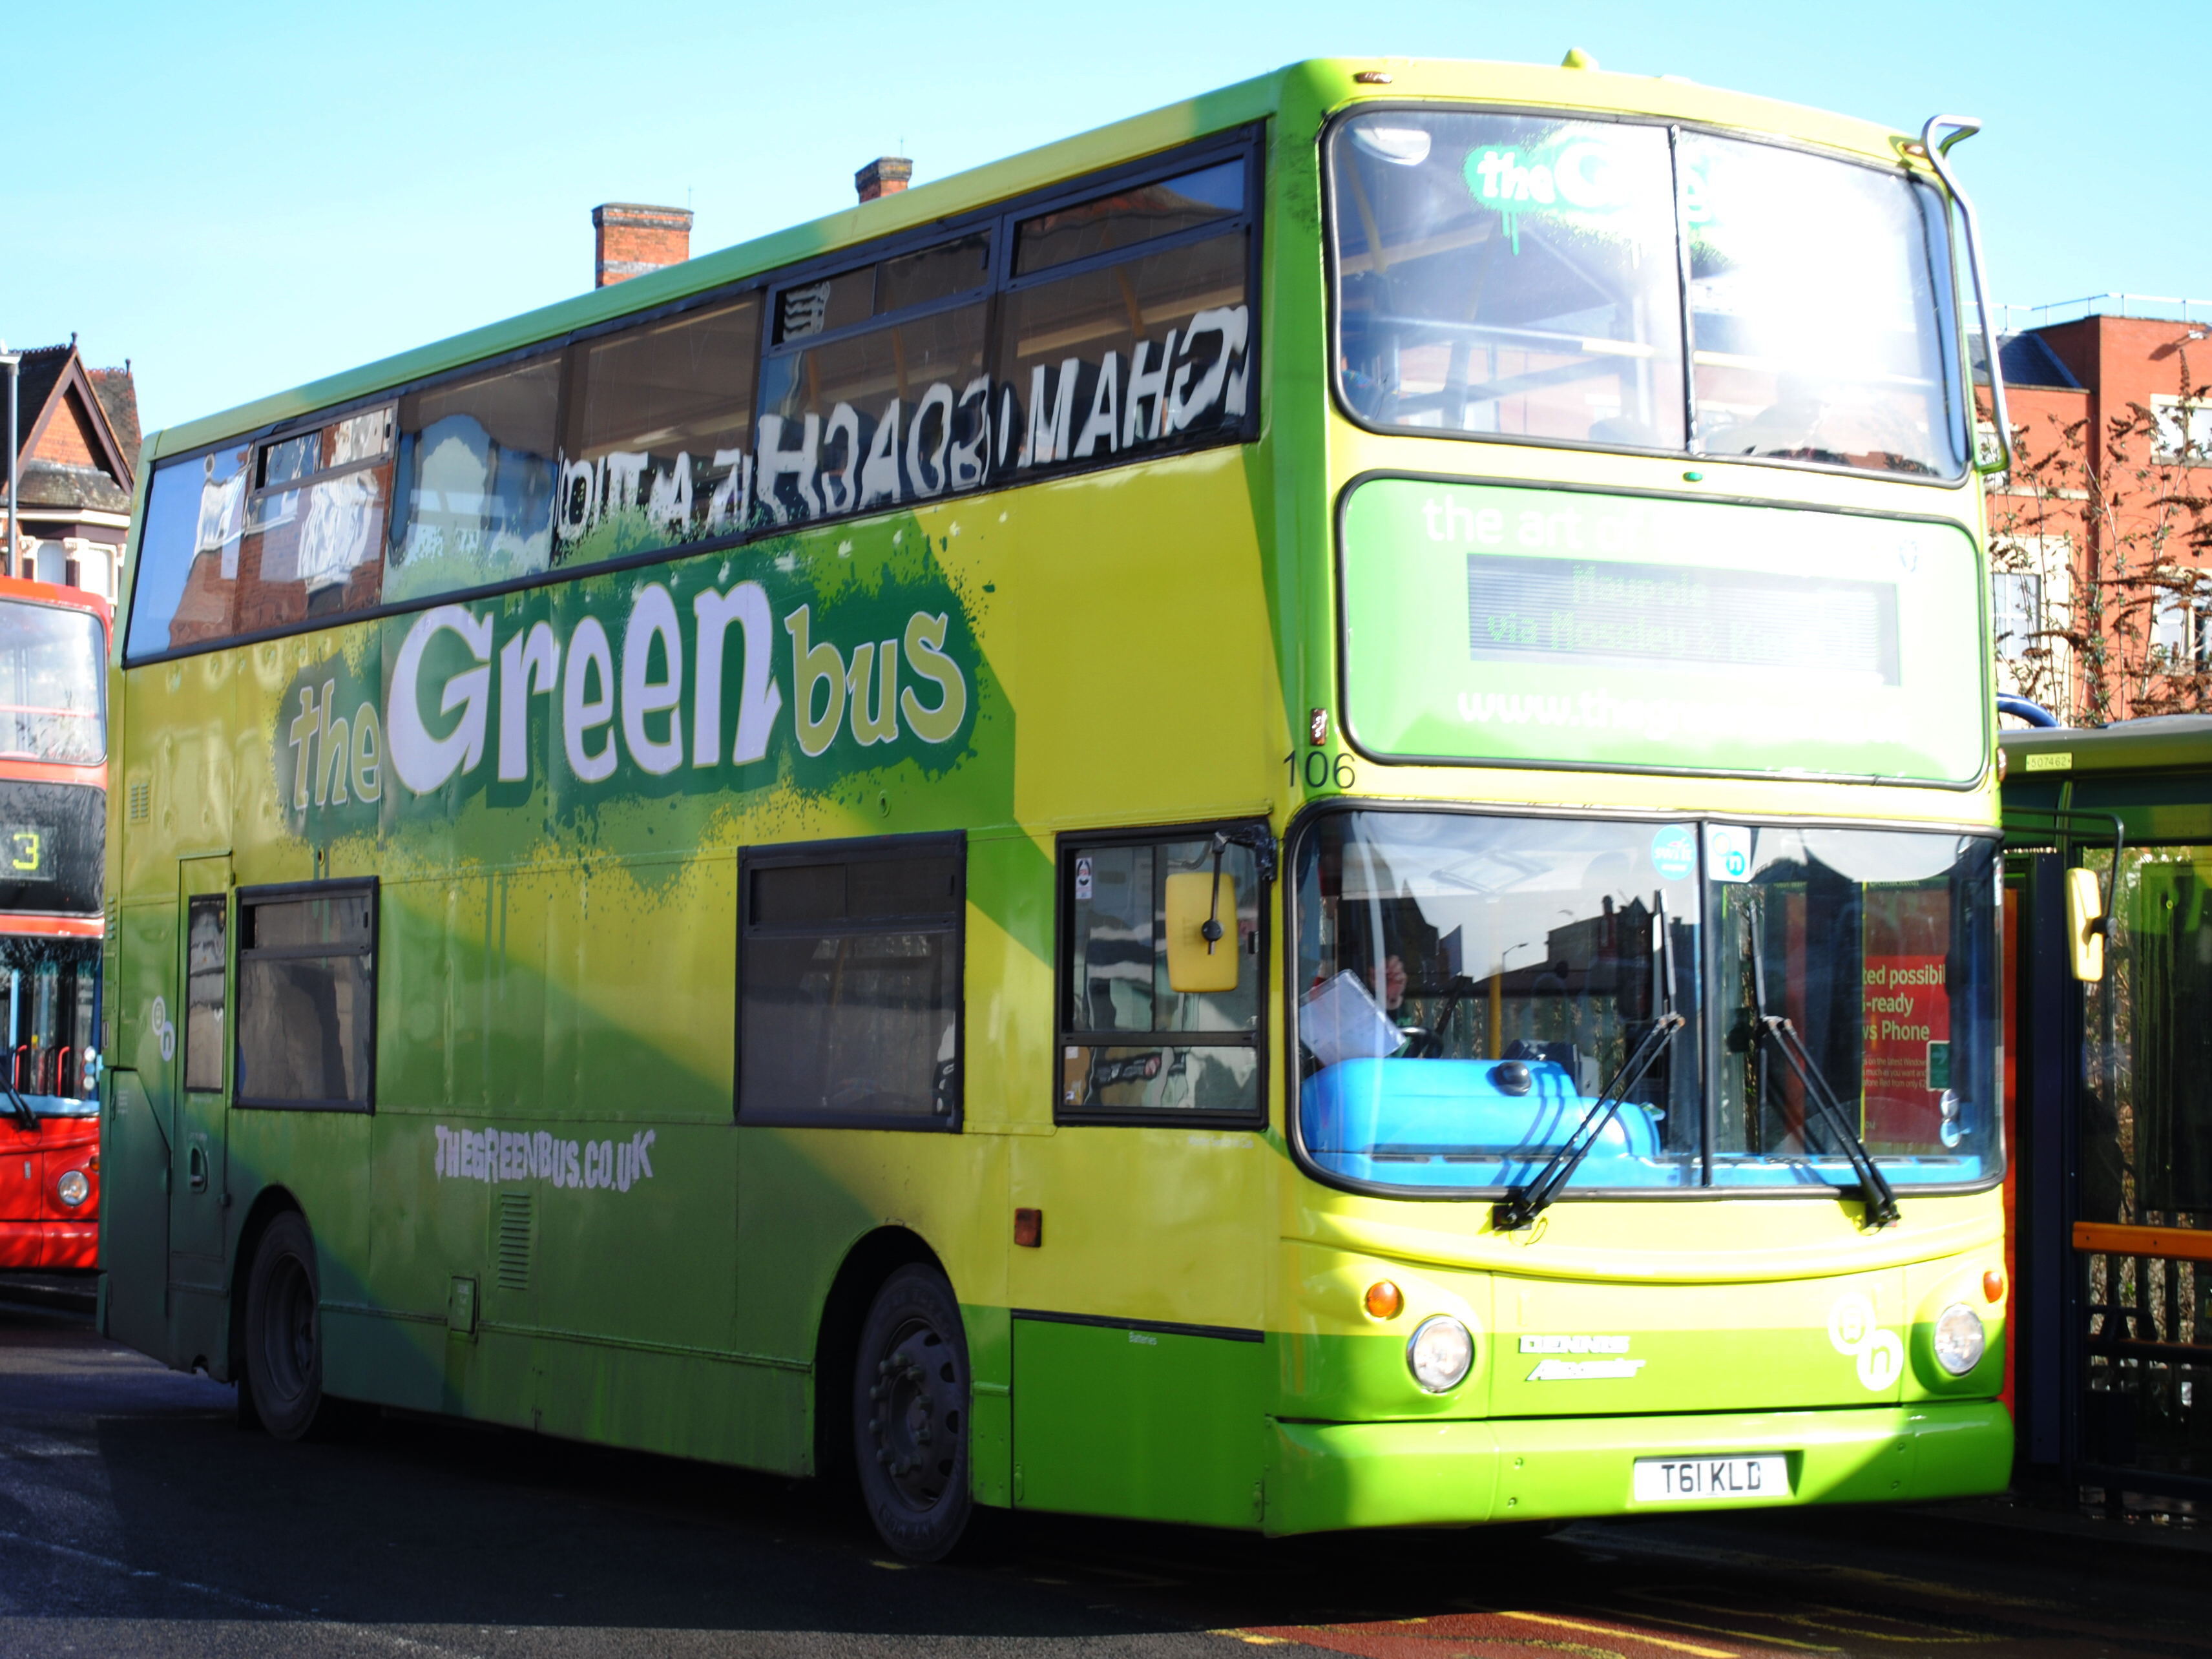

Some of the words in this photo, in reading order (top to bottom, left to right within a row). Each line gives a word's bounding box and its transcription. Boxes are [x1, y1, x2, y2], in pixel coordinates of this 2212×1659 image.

[1477, 150, 1556, 205] the
[1421, 493, 1504, 544] the
[1517, 505, 1583, 549] art
[1488, 613, 1538, 644] via
[287, 678, 382, 812] the
[386, 579, 781, 798] Green
[783, 603, 967, 757] bus
[1283, 749, 1356, 789] 106
[2030, 756, 2067, 767] 507462
[12, 833, 40, 871] 3
[1882, 1020, 1930, 1041] Phone
[435, 1125, 656, 1193] THEGREENBUS.CO.UK
[1128, 1331, 1158, 1346] Batteries
[1660, 1463, 1702, 1494] T61
[1710, 1461, 1762, 1493] KLD
